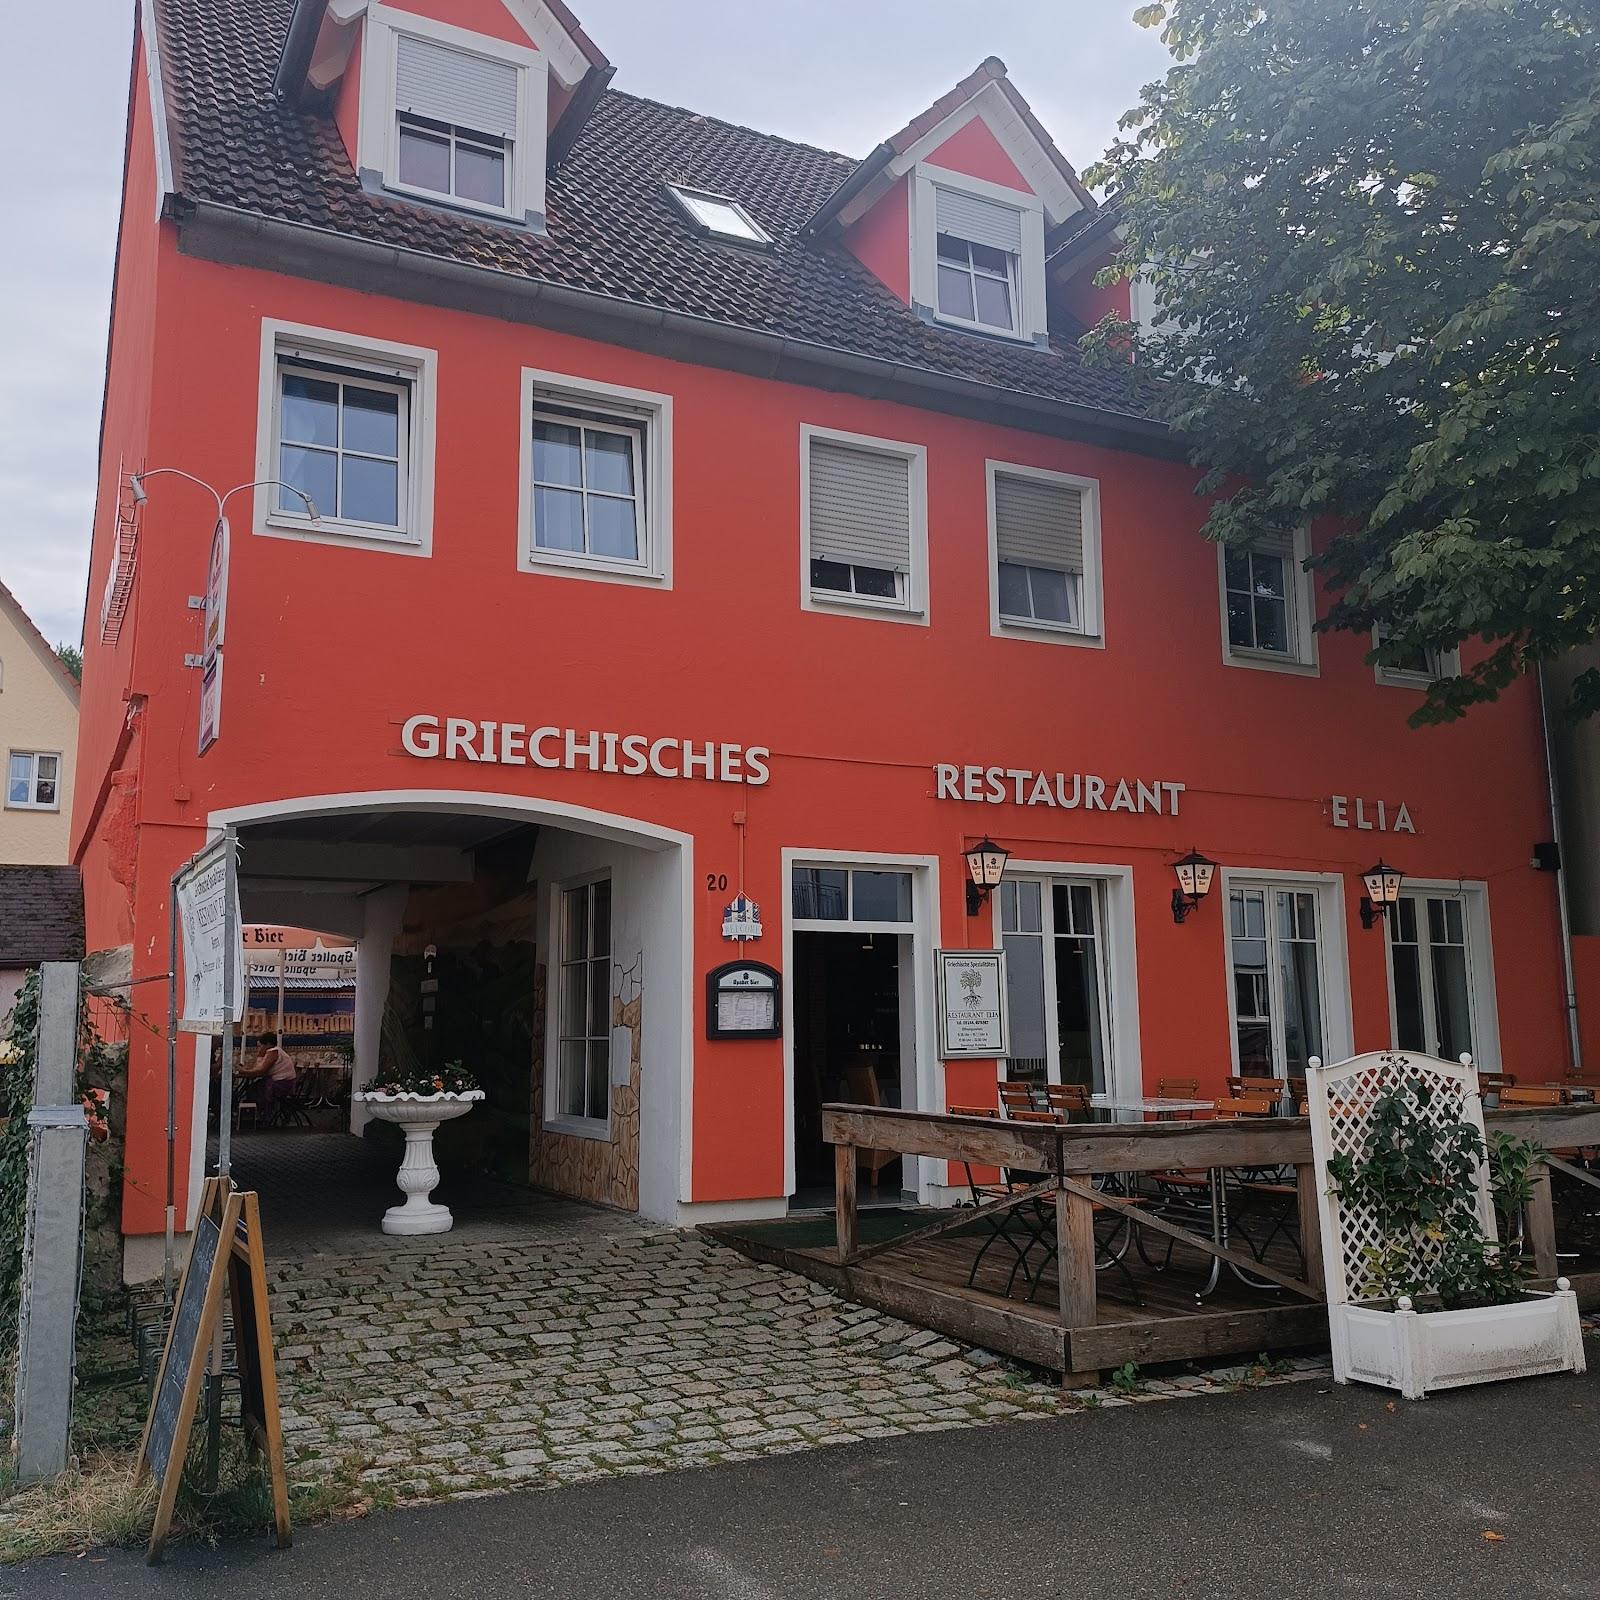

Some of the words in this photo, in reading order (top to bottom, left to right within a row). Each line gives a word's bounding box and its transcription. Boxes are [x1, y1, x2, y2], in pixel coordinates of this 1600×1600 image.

[400, 713, 771, 786] GRIECHISCHES
[935, 762, 1186, 816] RESTAURANT
[1331, 795, 1416, 834] ELIA
[706, 873, 728, 891] 20
[254, 928, 284, 943] Bier
[947, 1011, 985, 1019] RESTAURANT
